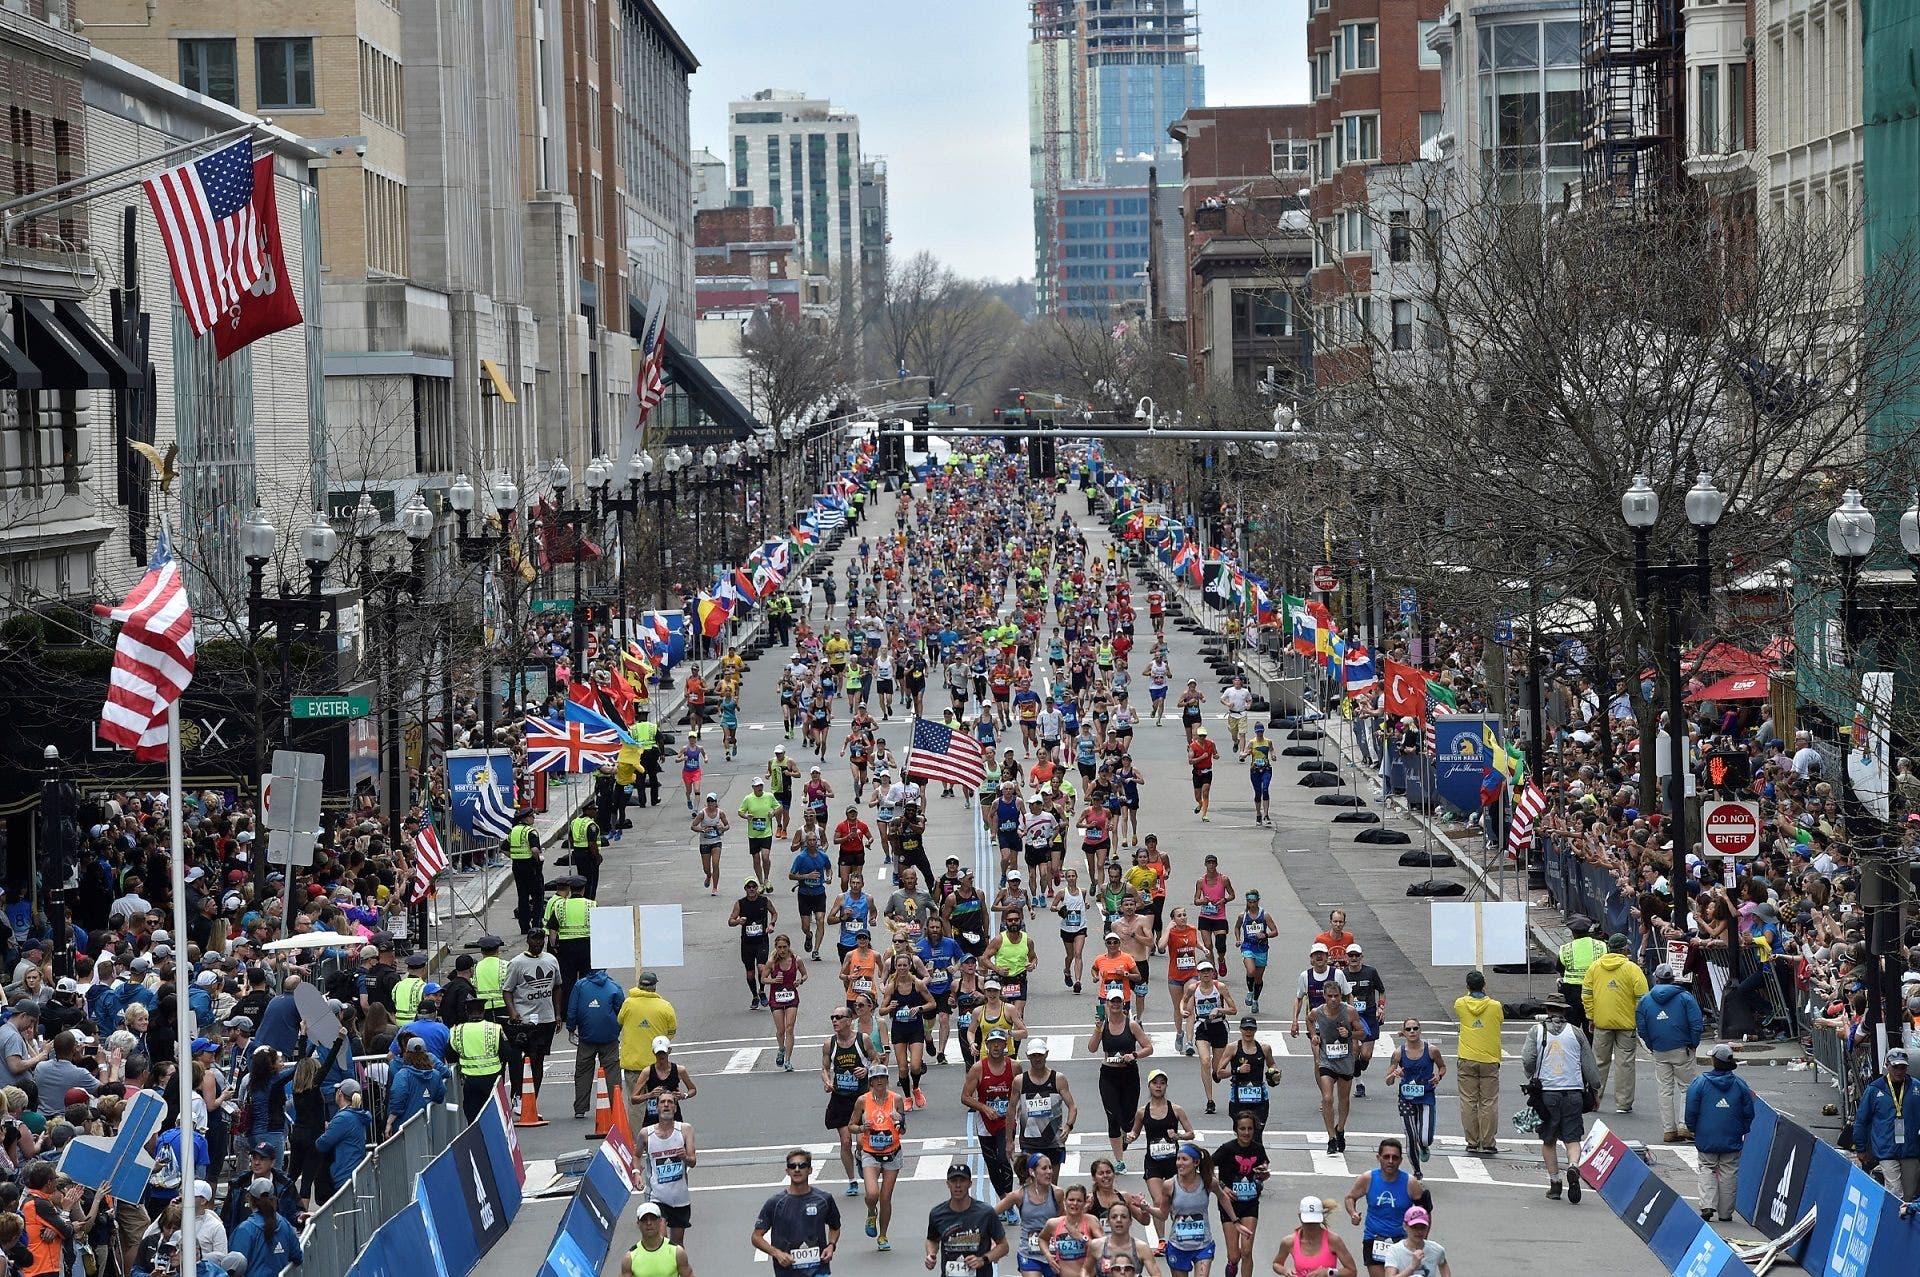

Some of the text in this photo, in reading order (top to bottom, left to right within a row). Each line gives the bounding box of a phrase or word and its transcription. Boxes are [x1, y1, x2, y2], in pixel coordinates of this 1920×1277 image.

[308, 701, 360, 716] EXETER ST
[1712, 814, 1750, 823] DO NOT
[1715, 835, 1747, 844] ENTER
[1327, 1043, 1349, 1052] 14495
[1239, 1086, 1262, 1096] 18242
[1401, 1084, 1424, 1094] 18553
[1028, 1097, 1049, 1108] 9156
[1309, 1203, 1315, 1213] S
[1176, 1221, 1204, 1232] 17396
[791, 1248, 820, 1260] 10017
